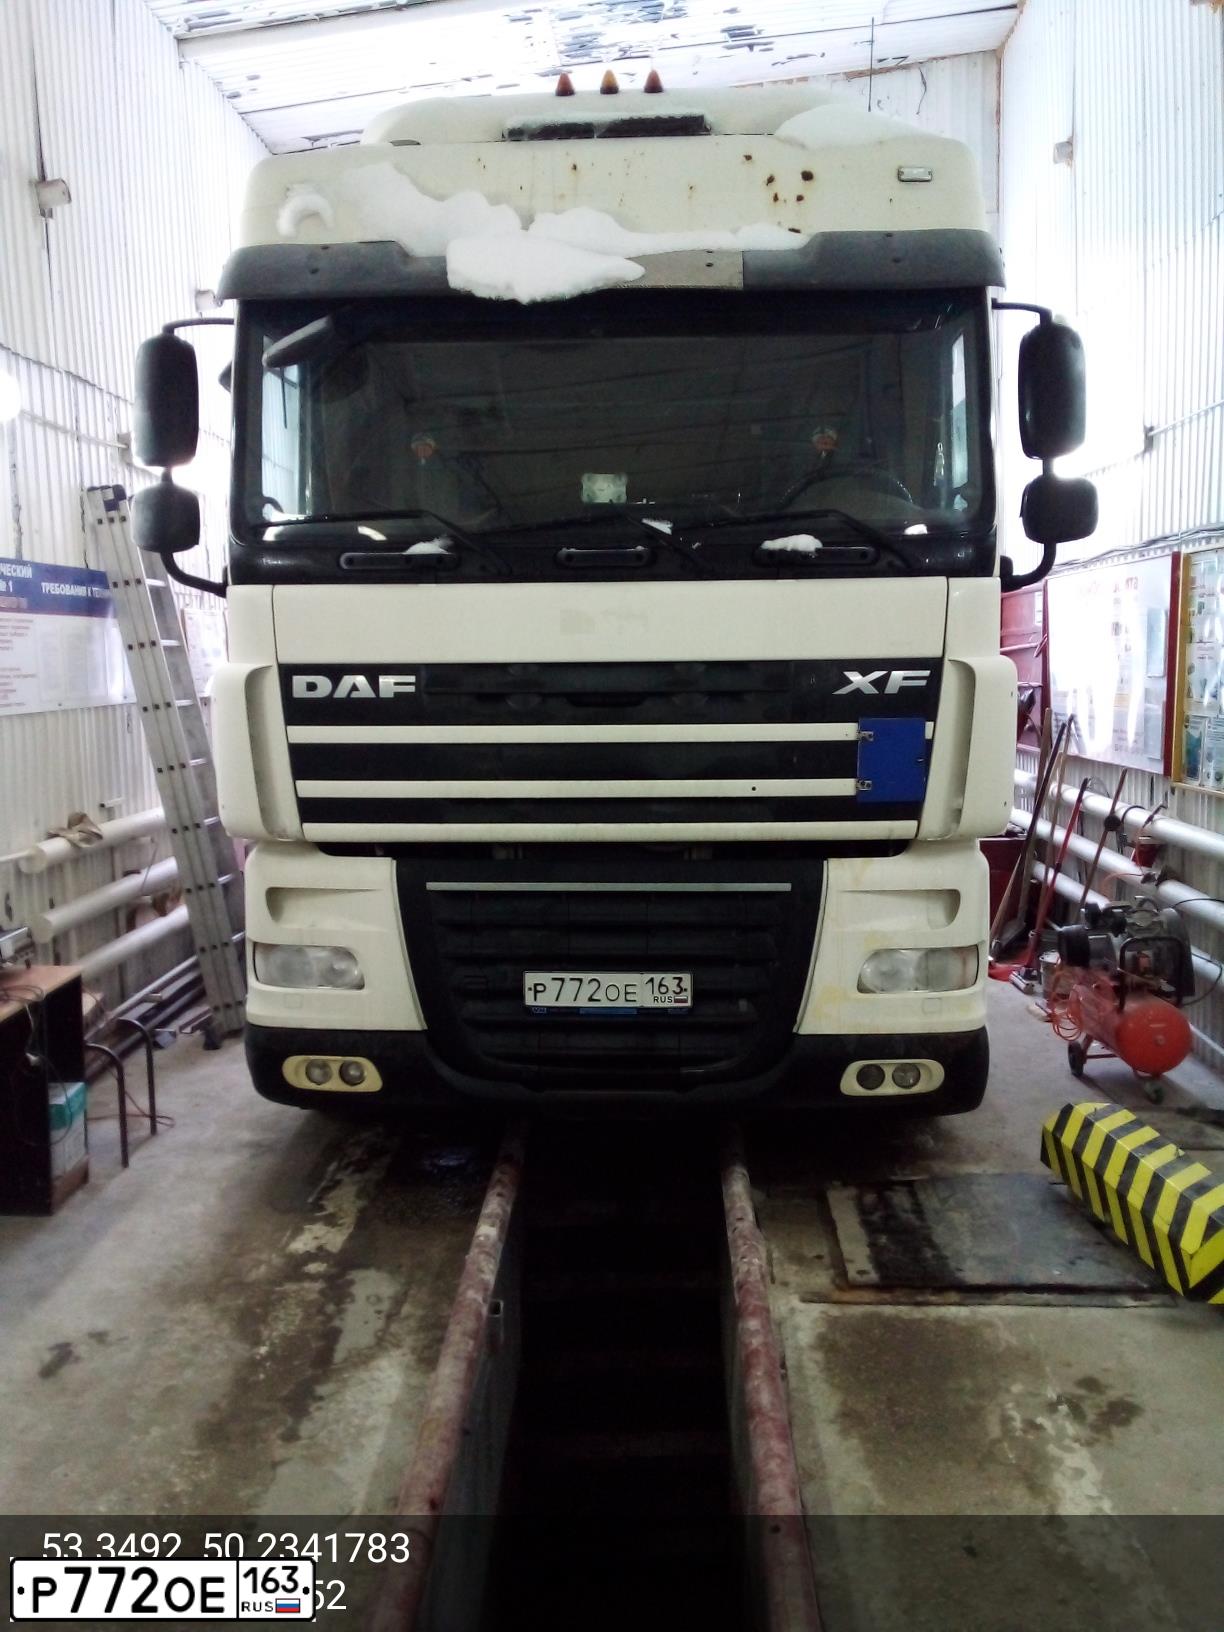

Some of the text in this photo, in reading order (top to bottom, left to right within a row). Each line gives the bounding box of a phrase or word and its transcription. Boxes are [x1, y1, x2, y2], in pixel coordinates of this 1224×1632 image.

[292, 675, 416, 698] DAF
[832, 670, 931, 694] XF
[645, 976, 684, 995] 163
